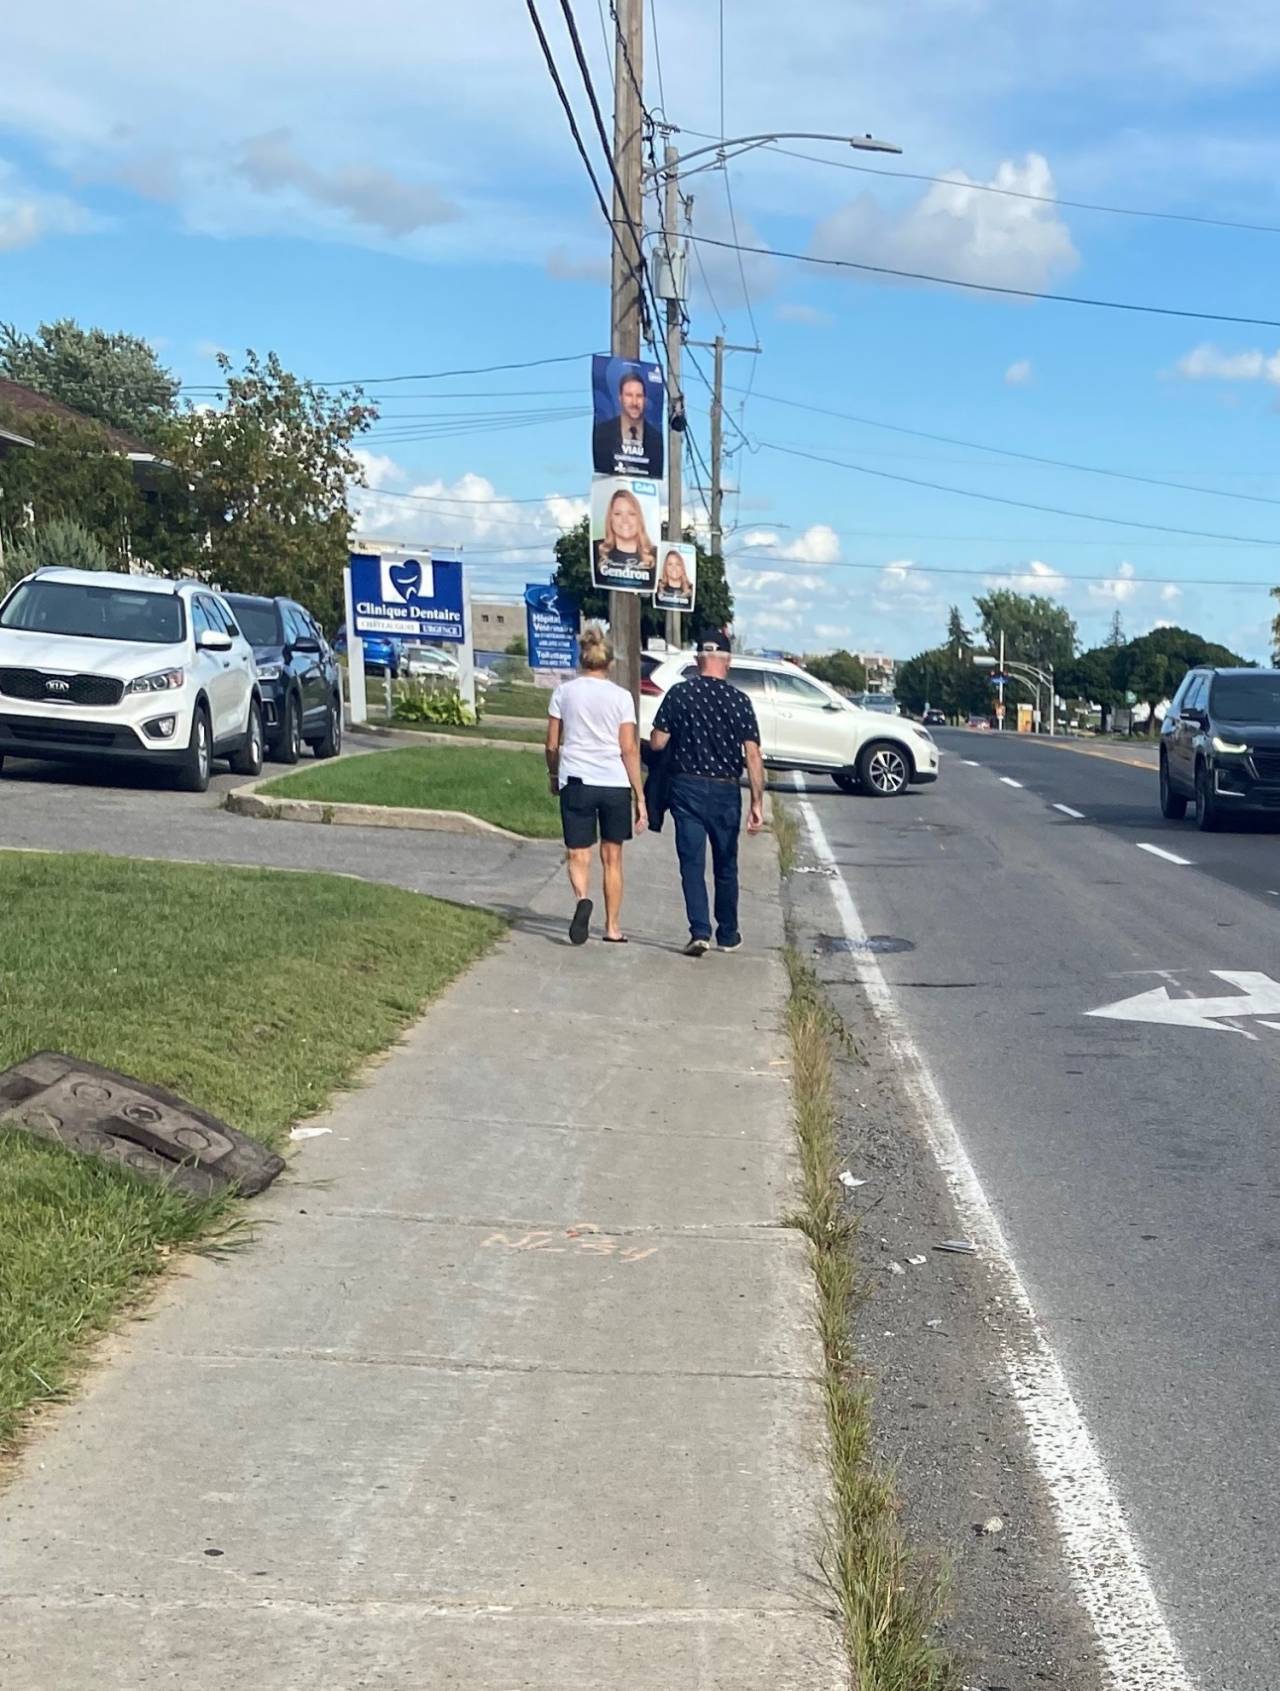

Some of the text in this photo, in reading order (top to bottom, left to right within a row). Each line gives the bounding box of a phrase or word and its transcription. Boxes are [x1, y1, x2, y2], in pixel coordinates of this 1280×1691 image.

[621, 444, 645, 456] VIAU
[600, 565, 650, 581] Gendron
[356, 602, 461, 621] Clinique Dentaire
[423, 624, 458, 635] URGENCE
